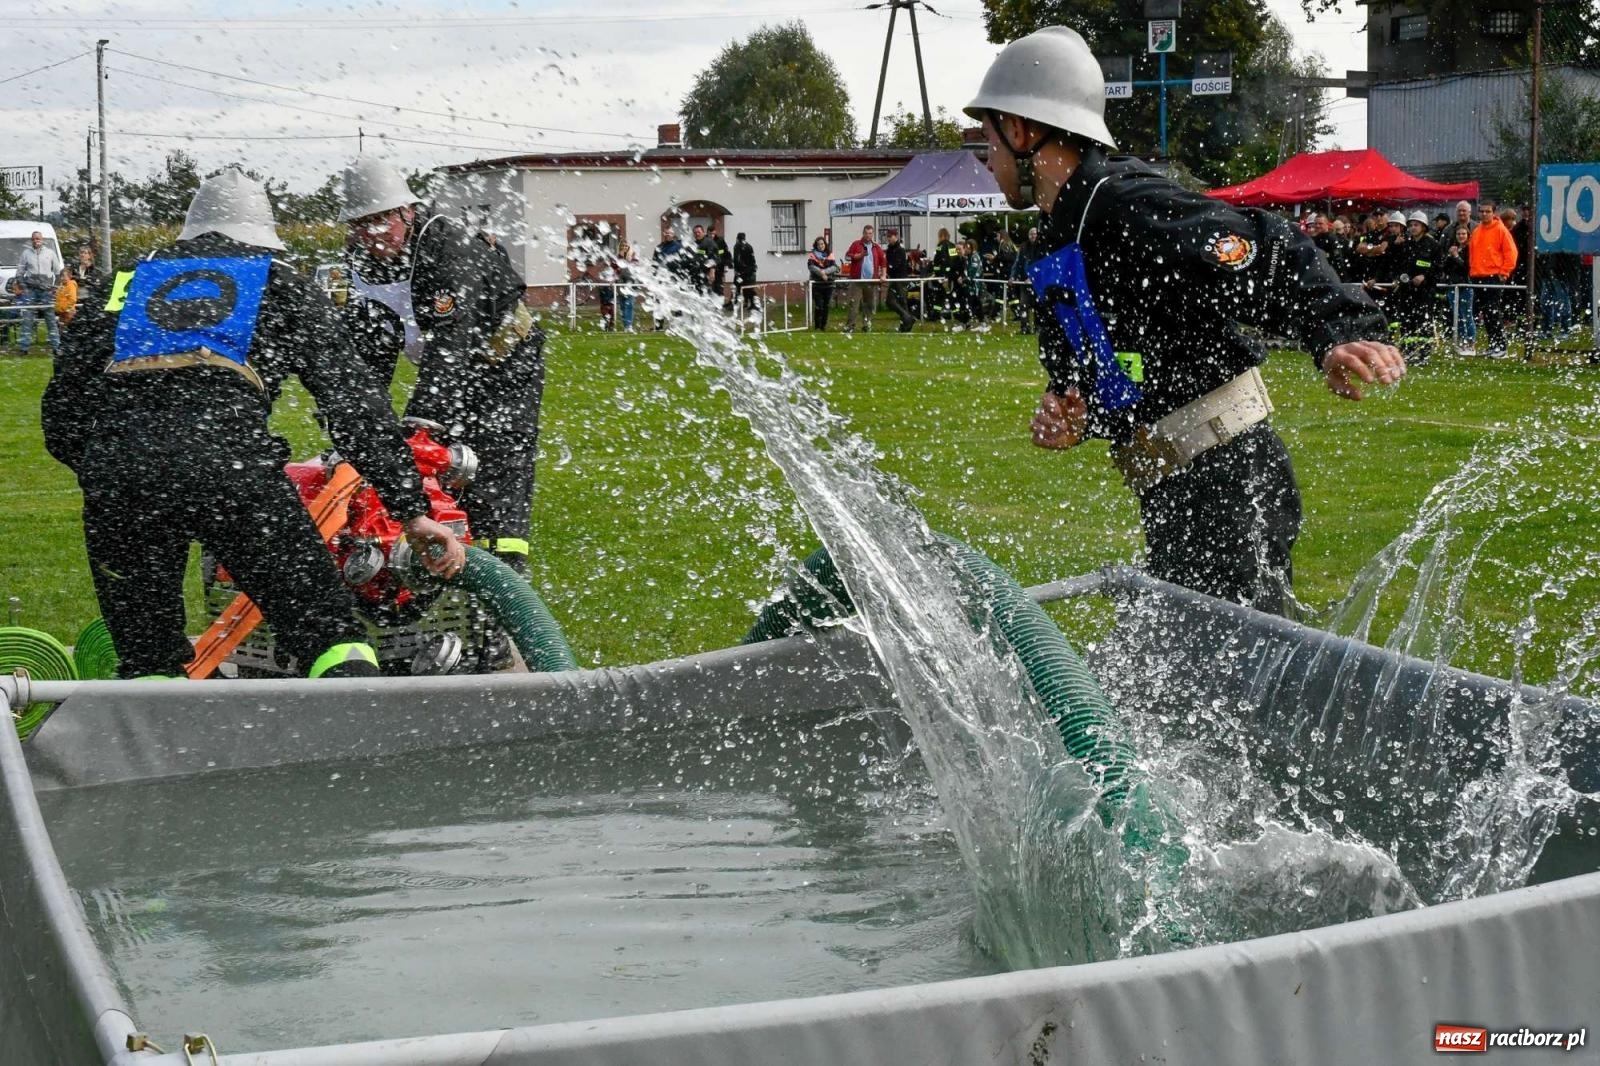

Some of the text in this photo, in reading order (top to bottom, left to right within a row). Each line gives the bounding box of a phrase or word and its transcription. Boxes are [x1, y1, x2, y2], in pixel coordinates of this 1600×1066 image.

[1104, 86, 1128, 96] TART
[1194, 81, 1231, 93] GOŚCIE
[937, 197, 996, 209] PROSAT
